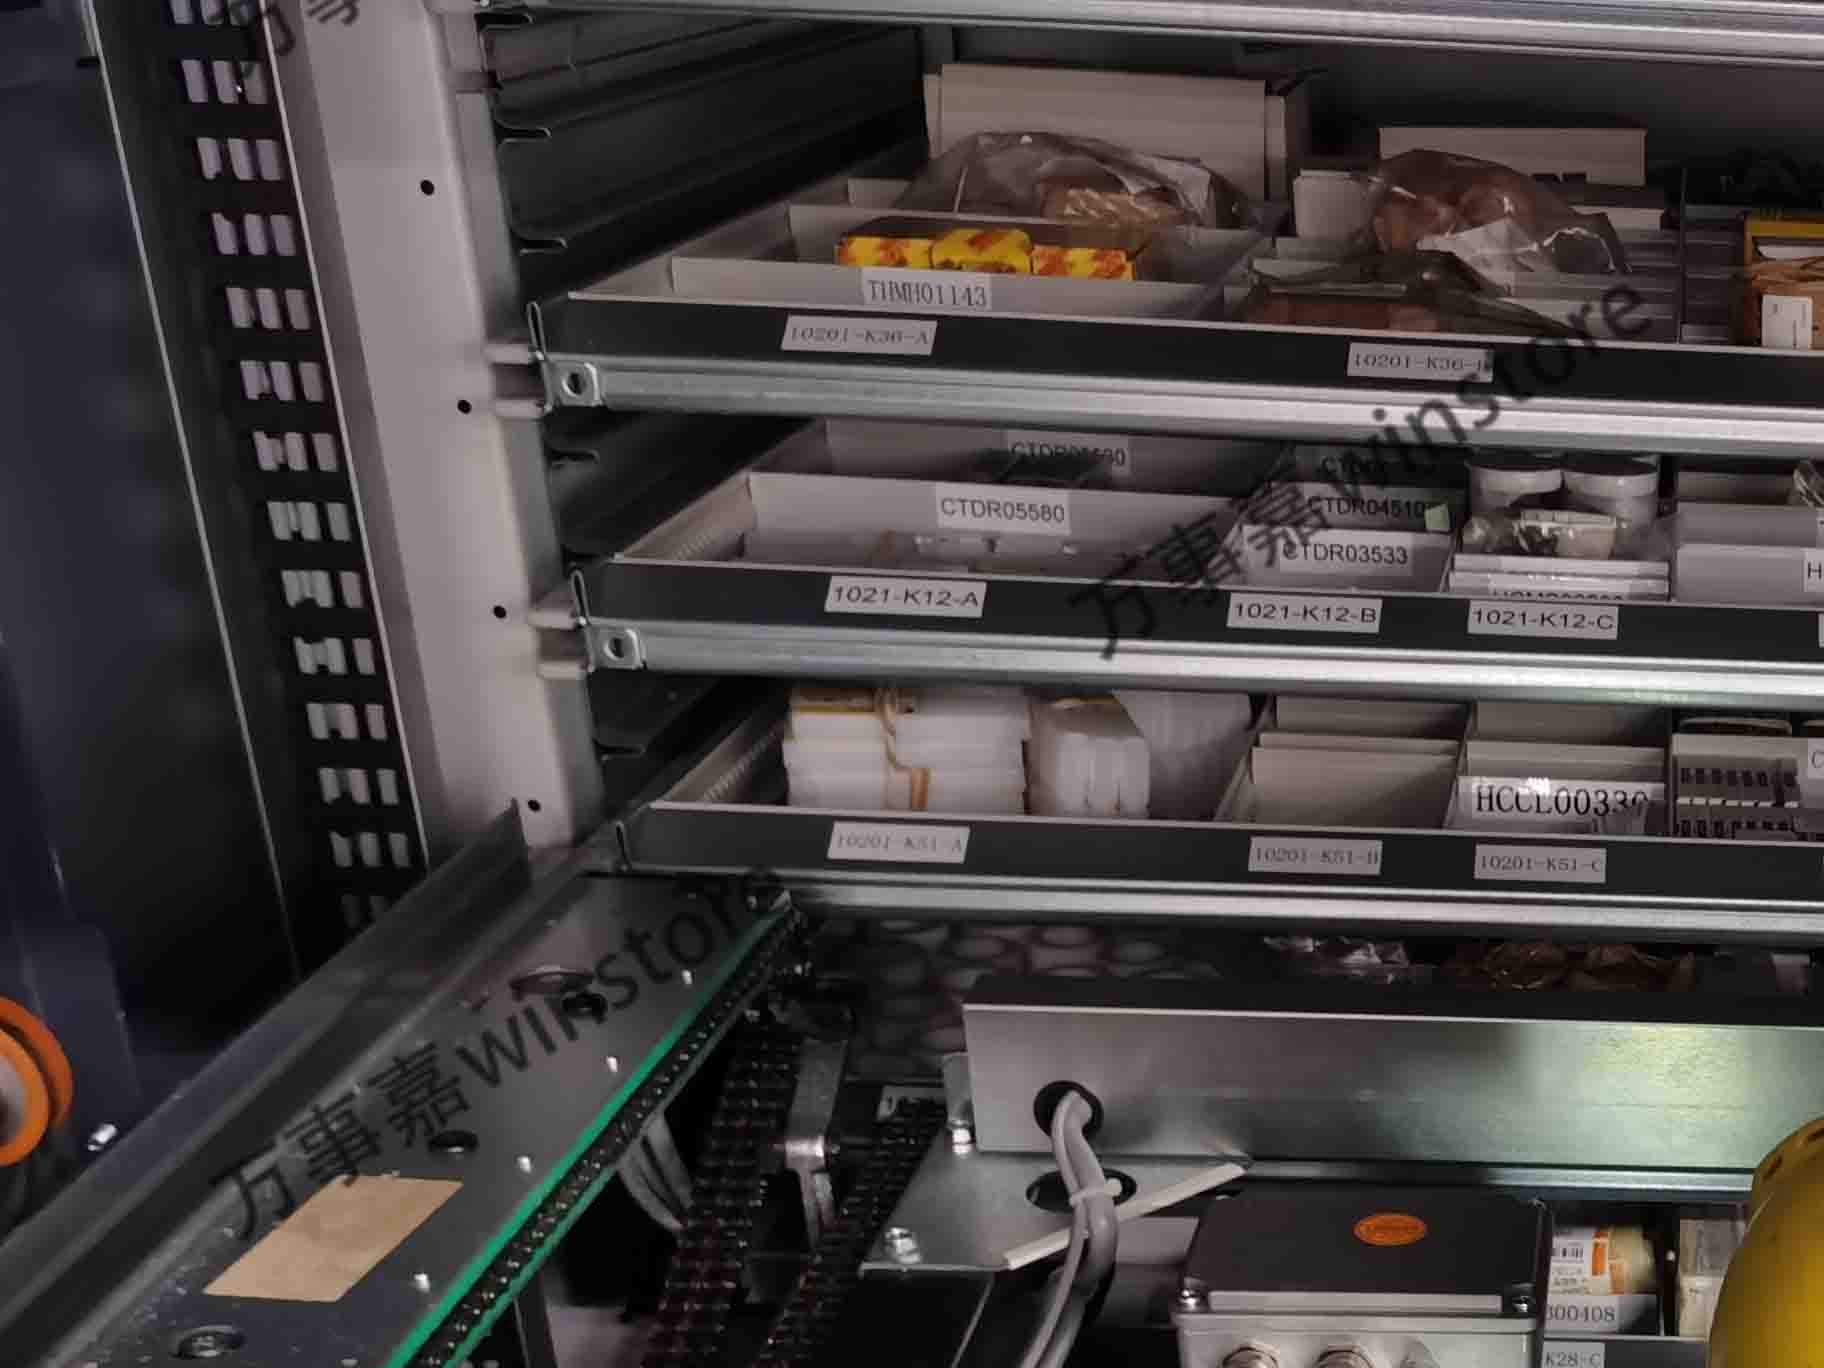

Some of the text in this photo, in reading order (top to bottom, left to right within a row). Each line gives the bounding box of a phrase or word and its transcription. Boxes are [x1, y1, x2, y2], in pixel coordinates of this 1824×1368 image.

[941, 498, 1065, 522] CTDR05580
[833, 586, 979, 608] 1021-K12-A
[1234, 603, 1376, 623] 1021-K12-B
[1472, 609, 1613, 631] 1021-K12-C
